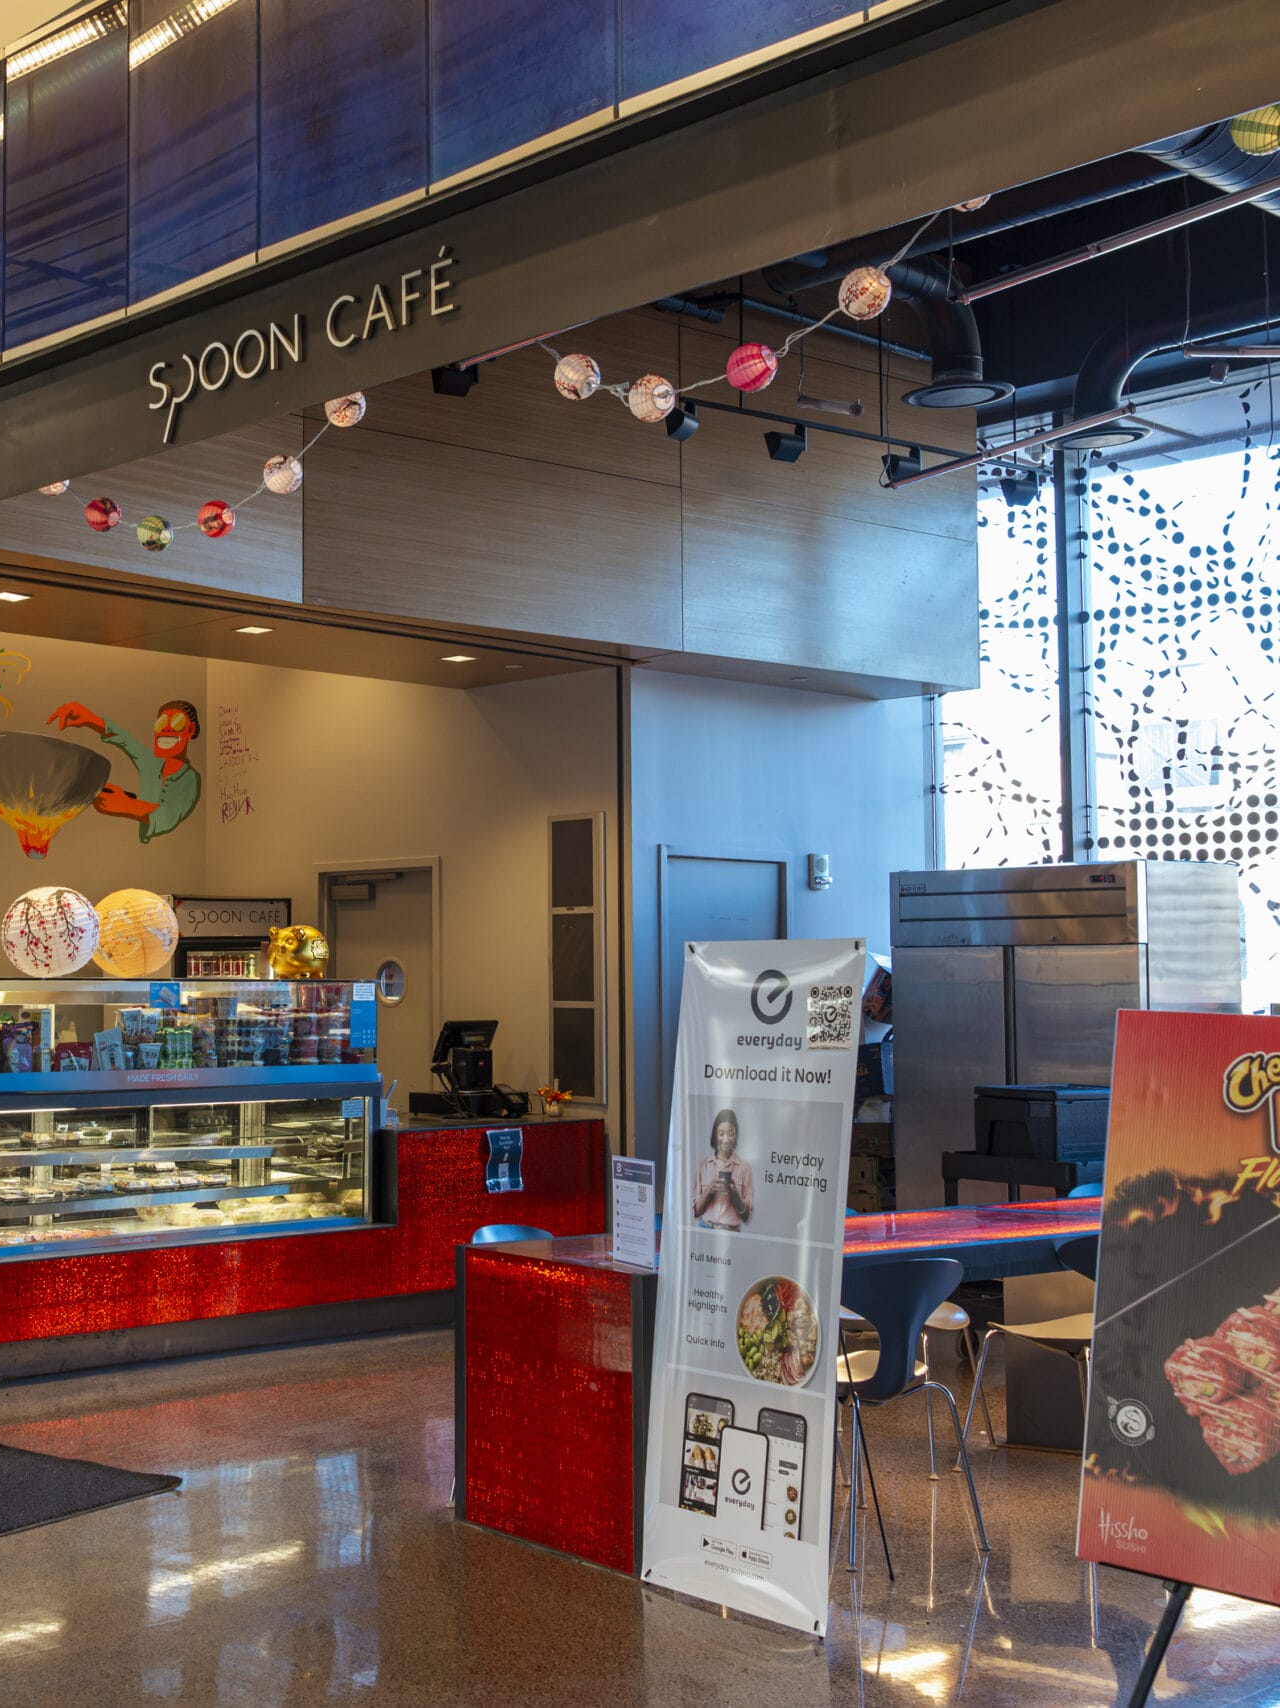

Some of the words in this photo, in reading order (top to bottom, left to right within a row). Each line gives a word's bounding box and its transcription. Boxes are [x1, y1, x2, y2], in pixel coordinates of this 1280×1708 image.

[148, 312, 304, 444] SPOON
[325, 244, 456, 348] CAFÉ
[187, 909, 242, 933] SPOON
[736, 1032, 802, 1051] everyday
[127, 1073, 151, 1082] MADE
[151, 1072, 177, 1082] FRESH
[177, 1071, 200, 1081] DAILY
[704, 1064, 777, 1081] Download
[781, 1066, 791, 1082] it
[794, 1068, 832, 1084] Now!
[770, 1151, 825, 1171] Everyday
[764, 1169, 774, 1183] is
[776, 1172, 828, 1193] Amazing
[690, 1252, 705, 1262] Full
[705, 1254, 732, 1266] Menus
[693, 1288, 724, 1302] Healthy
[688, 1299, 728, 1313] Highlights
[686, 1334, 709, 1346] Quick
[710, 1339, 726, 1349] Info
[724, 1495, 755, 1511] everyday
[1098, 1506, 1149, 1545] Hissho
[1115, 1539, 1147, 1553] SUSHI
